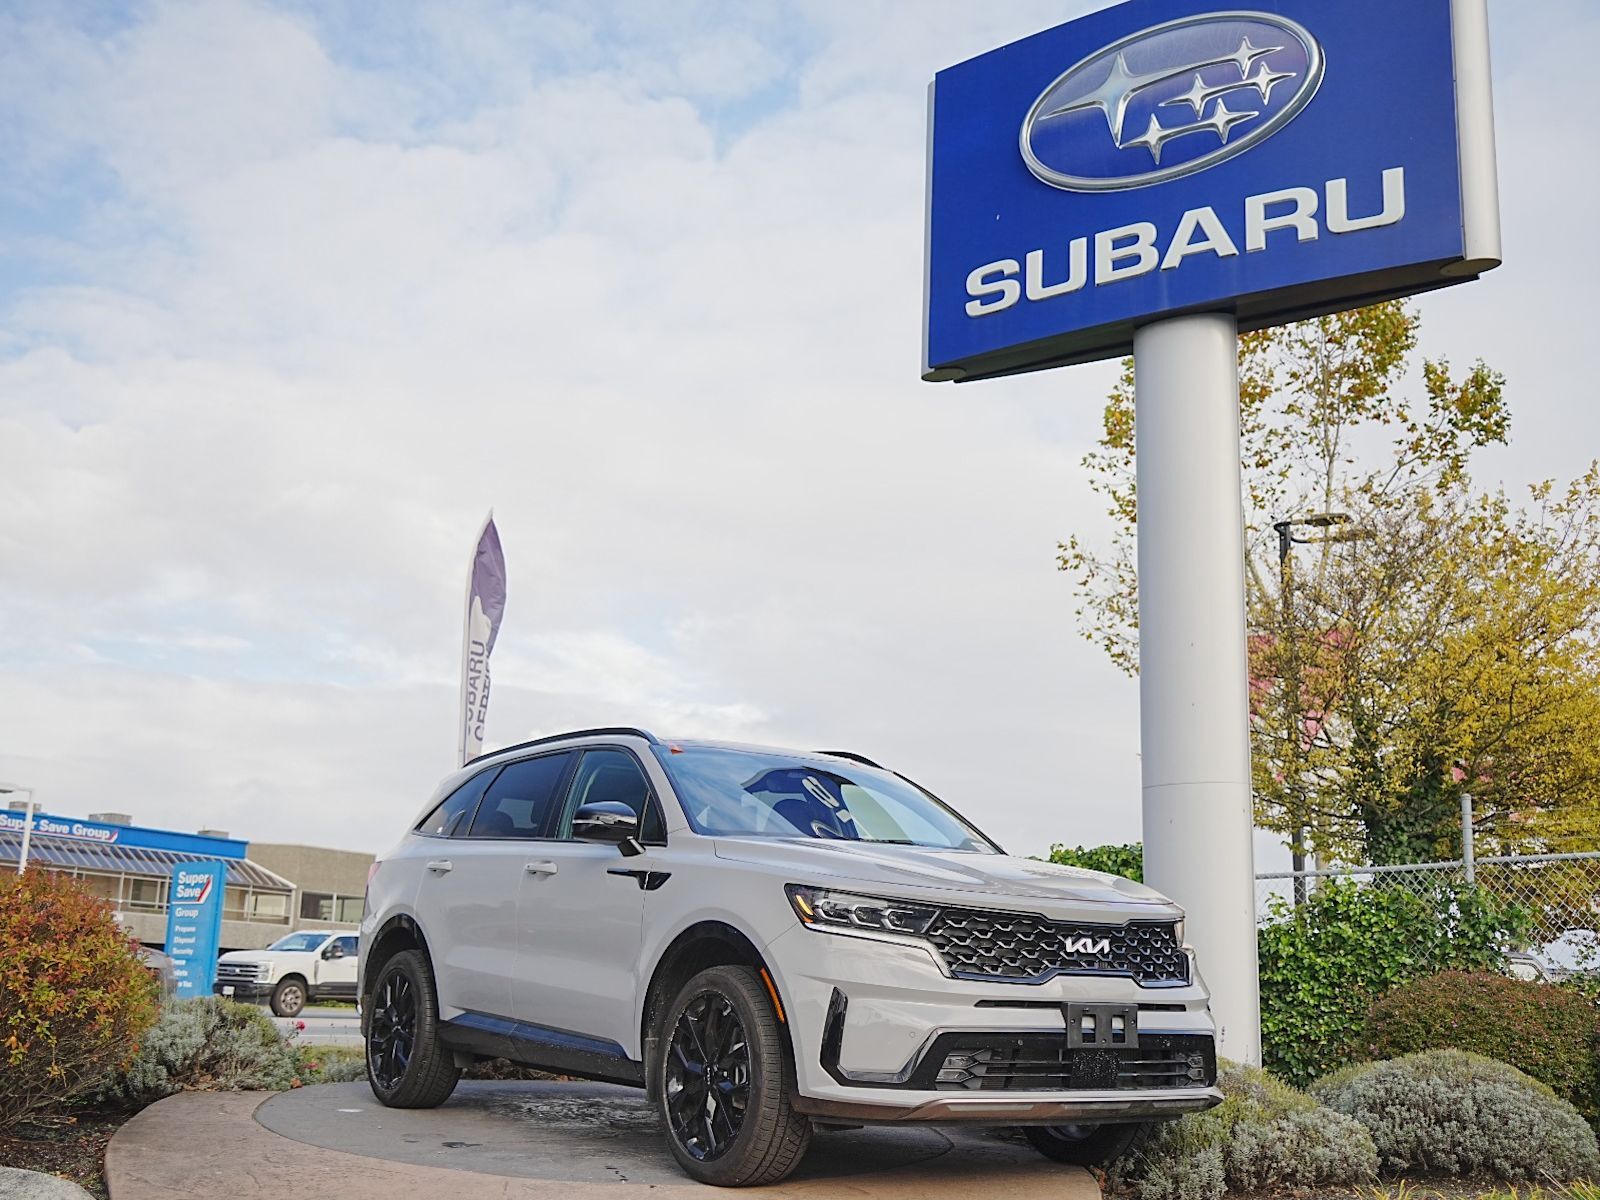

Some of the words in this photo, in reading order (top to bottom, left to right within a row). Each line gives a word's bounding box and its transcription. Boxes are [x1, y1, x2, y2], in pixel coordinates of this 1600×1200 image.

[965, 166, 1406, 319] SUBARU
[0, 814, 36, 830] Supr
[40, 819, 70, 834] Save
[72, 823, 111, 841] Group
[178, 871, 209, 886] Super
[176, 885, 201, 898] Save
[175, 907, 199, 918] Group
